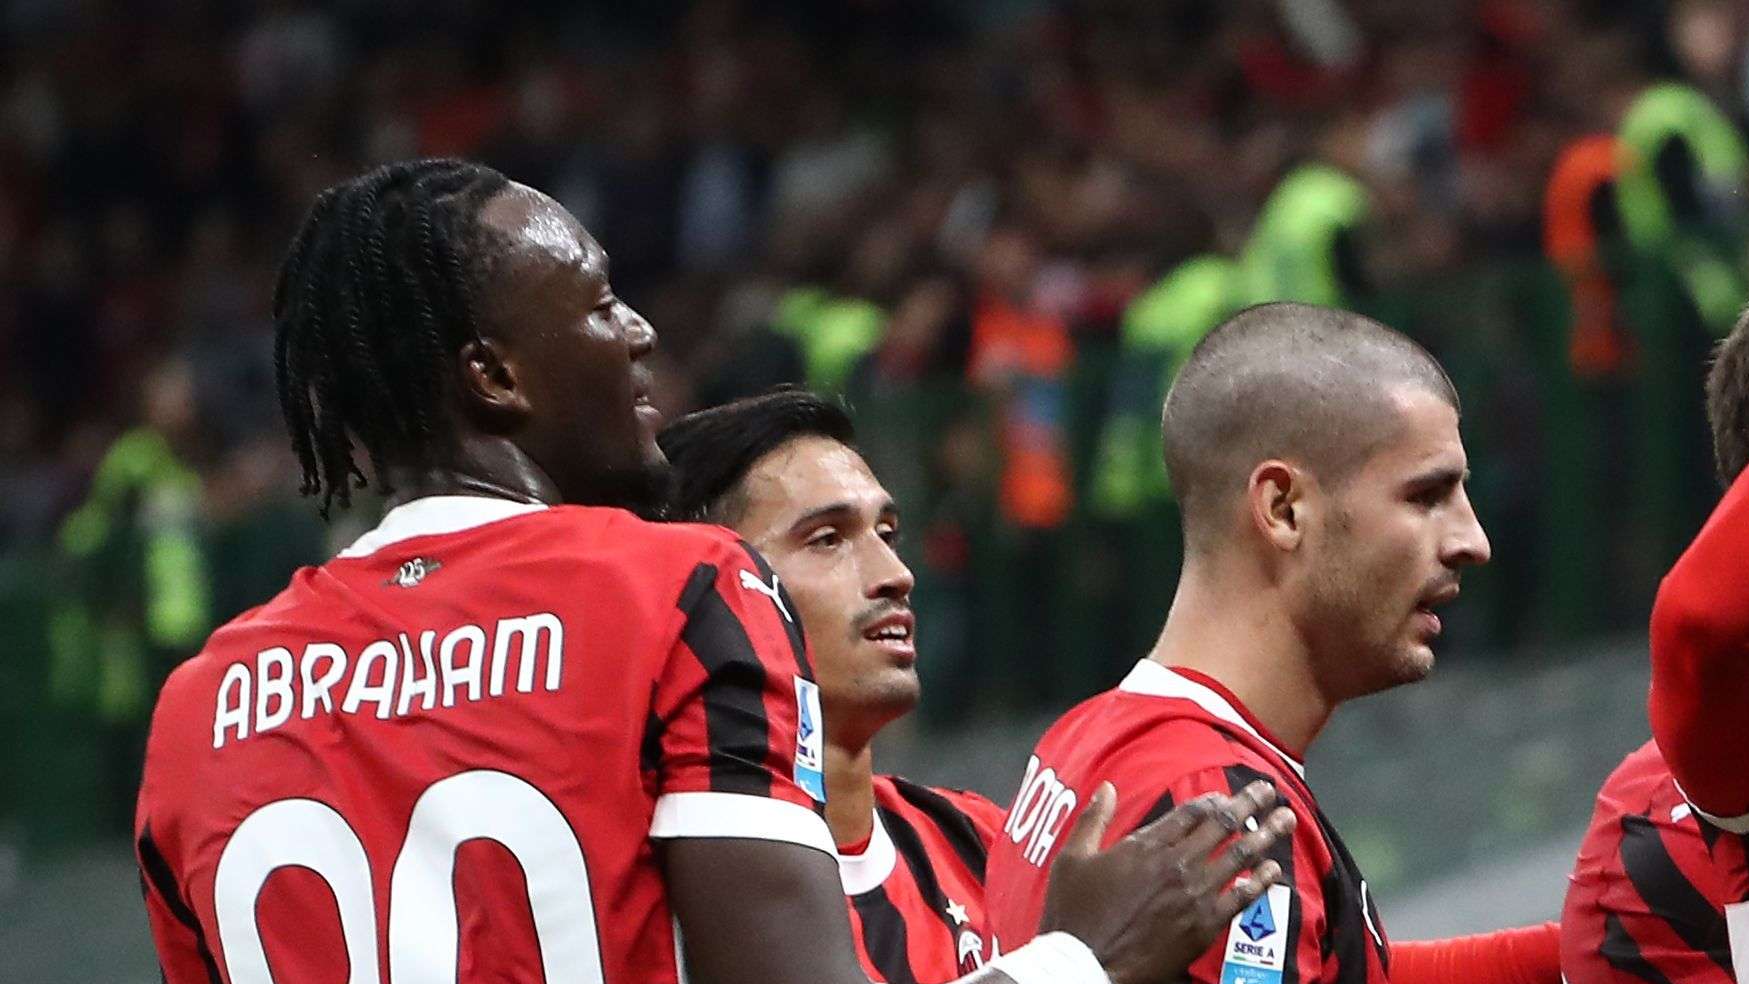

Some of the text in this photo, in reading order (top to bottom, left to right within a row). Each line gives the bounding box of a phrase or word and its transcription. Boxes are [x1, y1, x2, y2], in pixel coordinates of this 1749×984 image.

[211, 612, 564, 749] ABRAHAM
[1233, 941, 1275, 959] SERIE A
